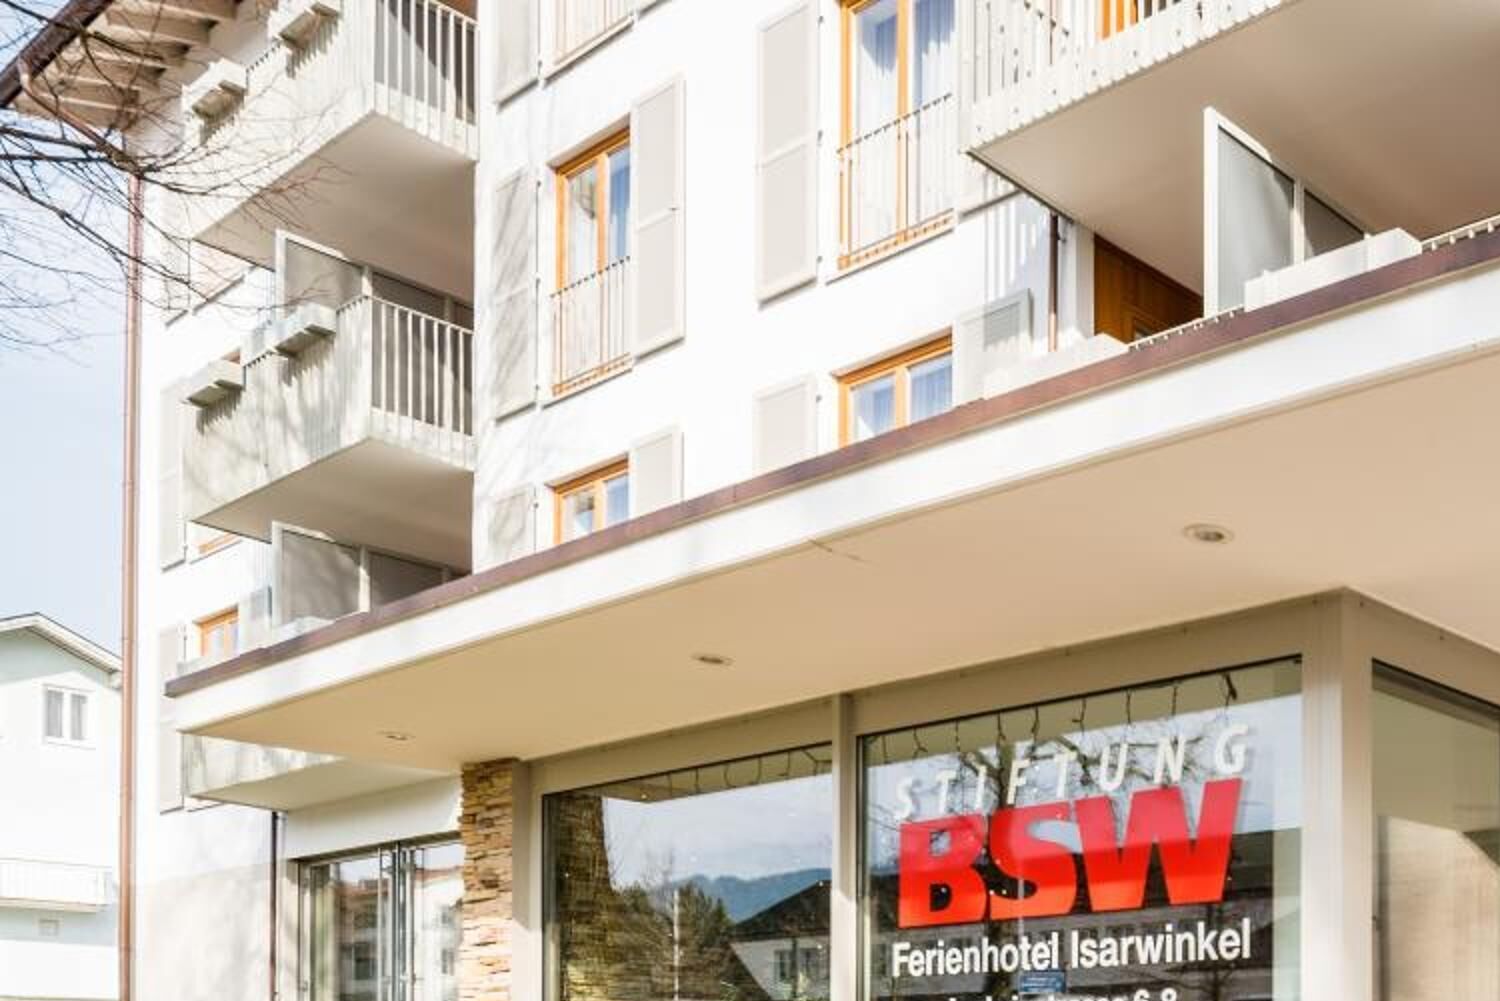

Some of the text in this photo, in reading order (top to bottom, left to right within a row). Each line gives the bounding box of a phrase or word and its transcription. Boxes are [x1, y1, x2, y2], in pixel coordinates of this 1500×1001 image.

[894, 724, 1249, 821] STIFTUNG
[898, 777, 1243, 929] BSW
[892, 918, 1252, 978] Ferienhotel Isarwinkel
